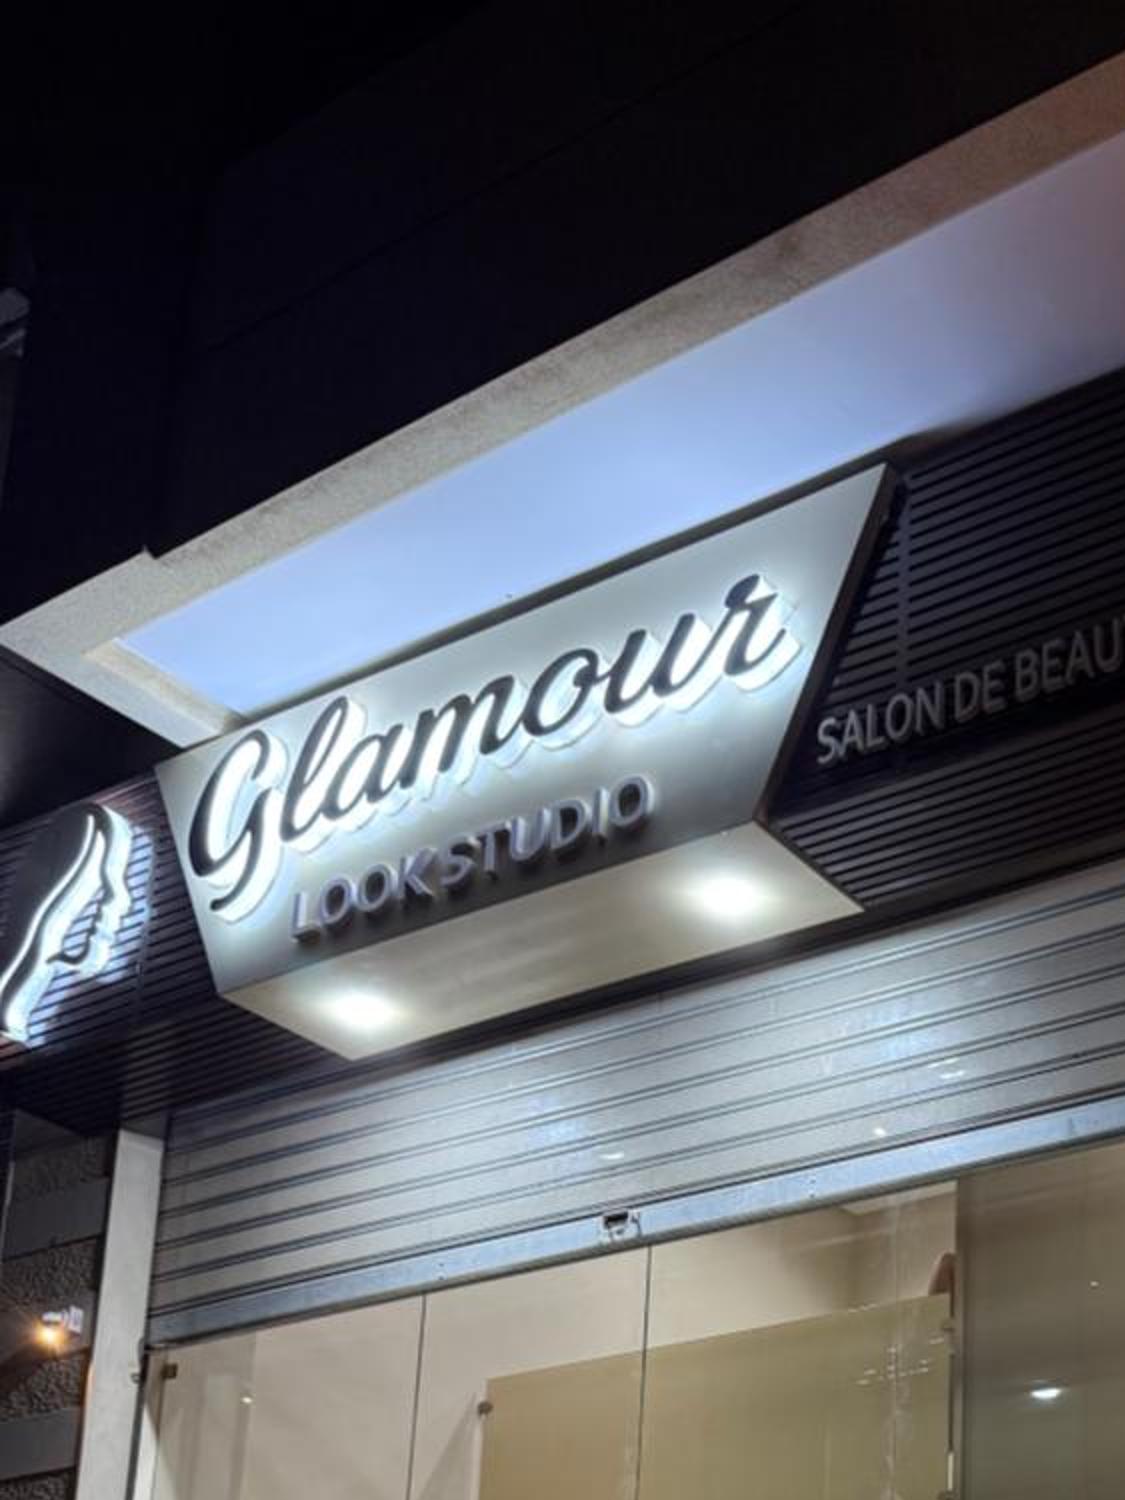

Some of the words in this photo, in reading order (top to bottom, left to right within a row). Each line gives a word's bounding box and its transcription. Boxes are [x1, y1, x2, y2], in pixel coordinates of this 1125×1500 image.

[188, 573, 796, 915] Glamour
[816, 681, 946, 765] SALON
[953, 660, 1007, 725] DE
